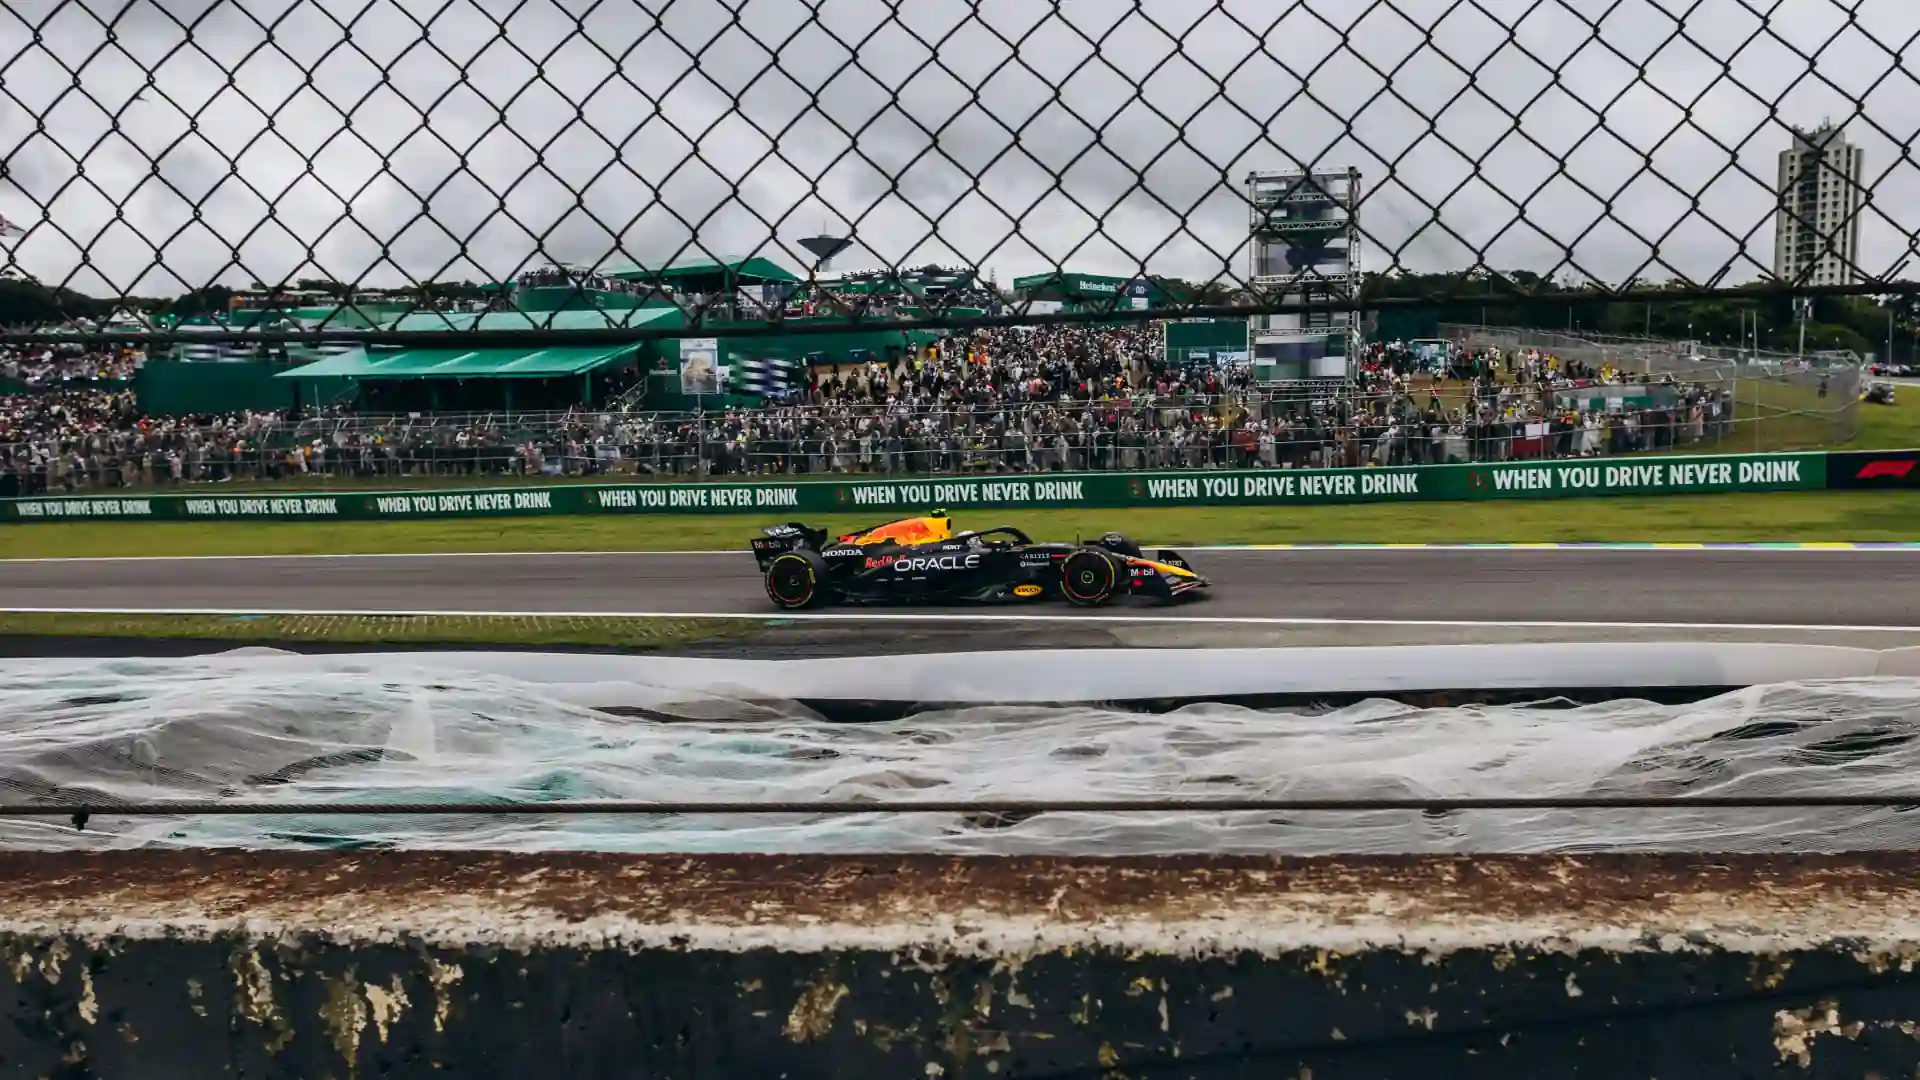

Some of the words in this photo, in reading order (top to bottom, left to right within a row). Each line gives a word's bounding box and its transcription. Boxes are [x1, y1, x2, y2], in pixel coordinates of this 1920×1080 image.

[1079, 280, 1117, 293] Heineken
[1493, 469, 1552, 490] WHEN
[1557, 467, 1600, 488] YOU
[1605, 465, 1664, 487] DRIVE
[1669, 464, 1732, 485] NEVER
[1738, 460, 1801, 483] DRINK
[852, 487, 896, 504] WHEN
[899, 486, 930, 503] YOU
[935, 484, 978, 502] DRIVE
[982, 483, 1030, 501] NEVER
[1034, 482, 1084, 500] DRINK
[1147, 479, 1198, 498] WHEN
[1202, 478, 1239, 497] YOU
[1244, 477, 1295, 496] DRIVE
[1300, 475, 1356, 495] NEVER
[1361, 473, 1418, 494] DRINK
[186, 500, 216, 514] WHEN
[217, 500, 238, 514] YOU
[240, 500, 270, 514] DRIVE
[271, 499, 303, 514] NEVER
[304, 499, 337, 514] DRINK
[377, 498, 411, 512] WHEN
[412, 496, 437, 512] YOU
[439, 495, 473, 511] DRIVE
[475, 494, 512, 510] NEVER
[515, 492, 551, 508] DRINK
[598, 490, 637, 507] WHEN
[638, 490, 667, 506] YOU
[670, 490, 707, 506] DRIVE
[710, 489, 752, 506] NEVER
[756, 488, 798, 505] DRINK
[16, 502, 44, 515] WHEN
[44, 502, 63, 515] YOU
[65, 501, 91, 514] DRIVE
[91, 501, 121, 514] NEVER
[122, 500, 152, 514] DRINK
[821, 549, 864, 558] HONDA
[894, 554, 981, 572] ORACLE
[1130, 567, 1155, 577] Mobil
